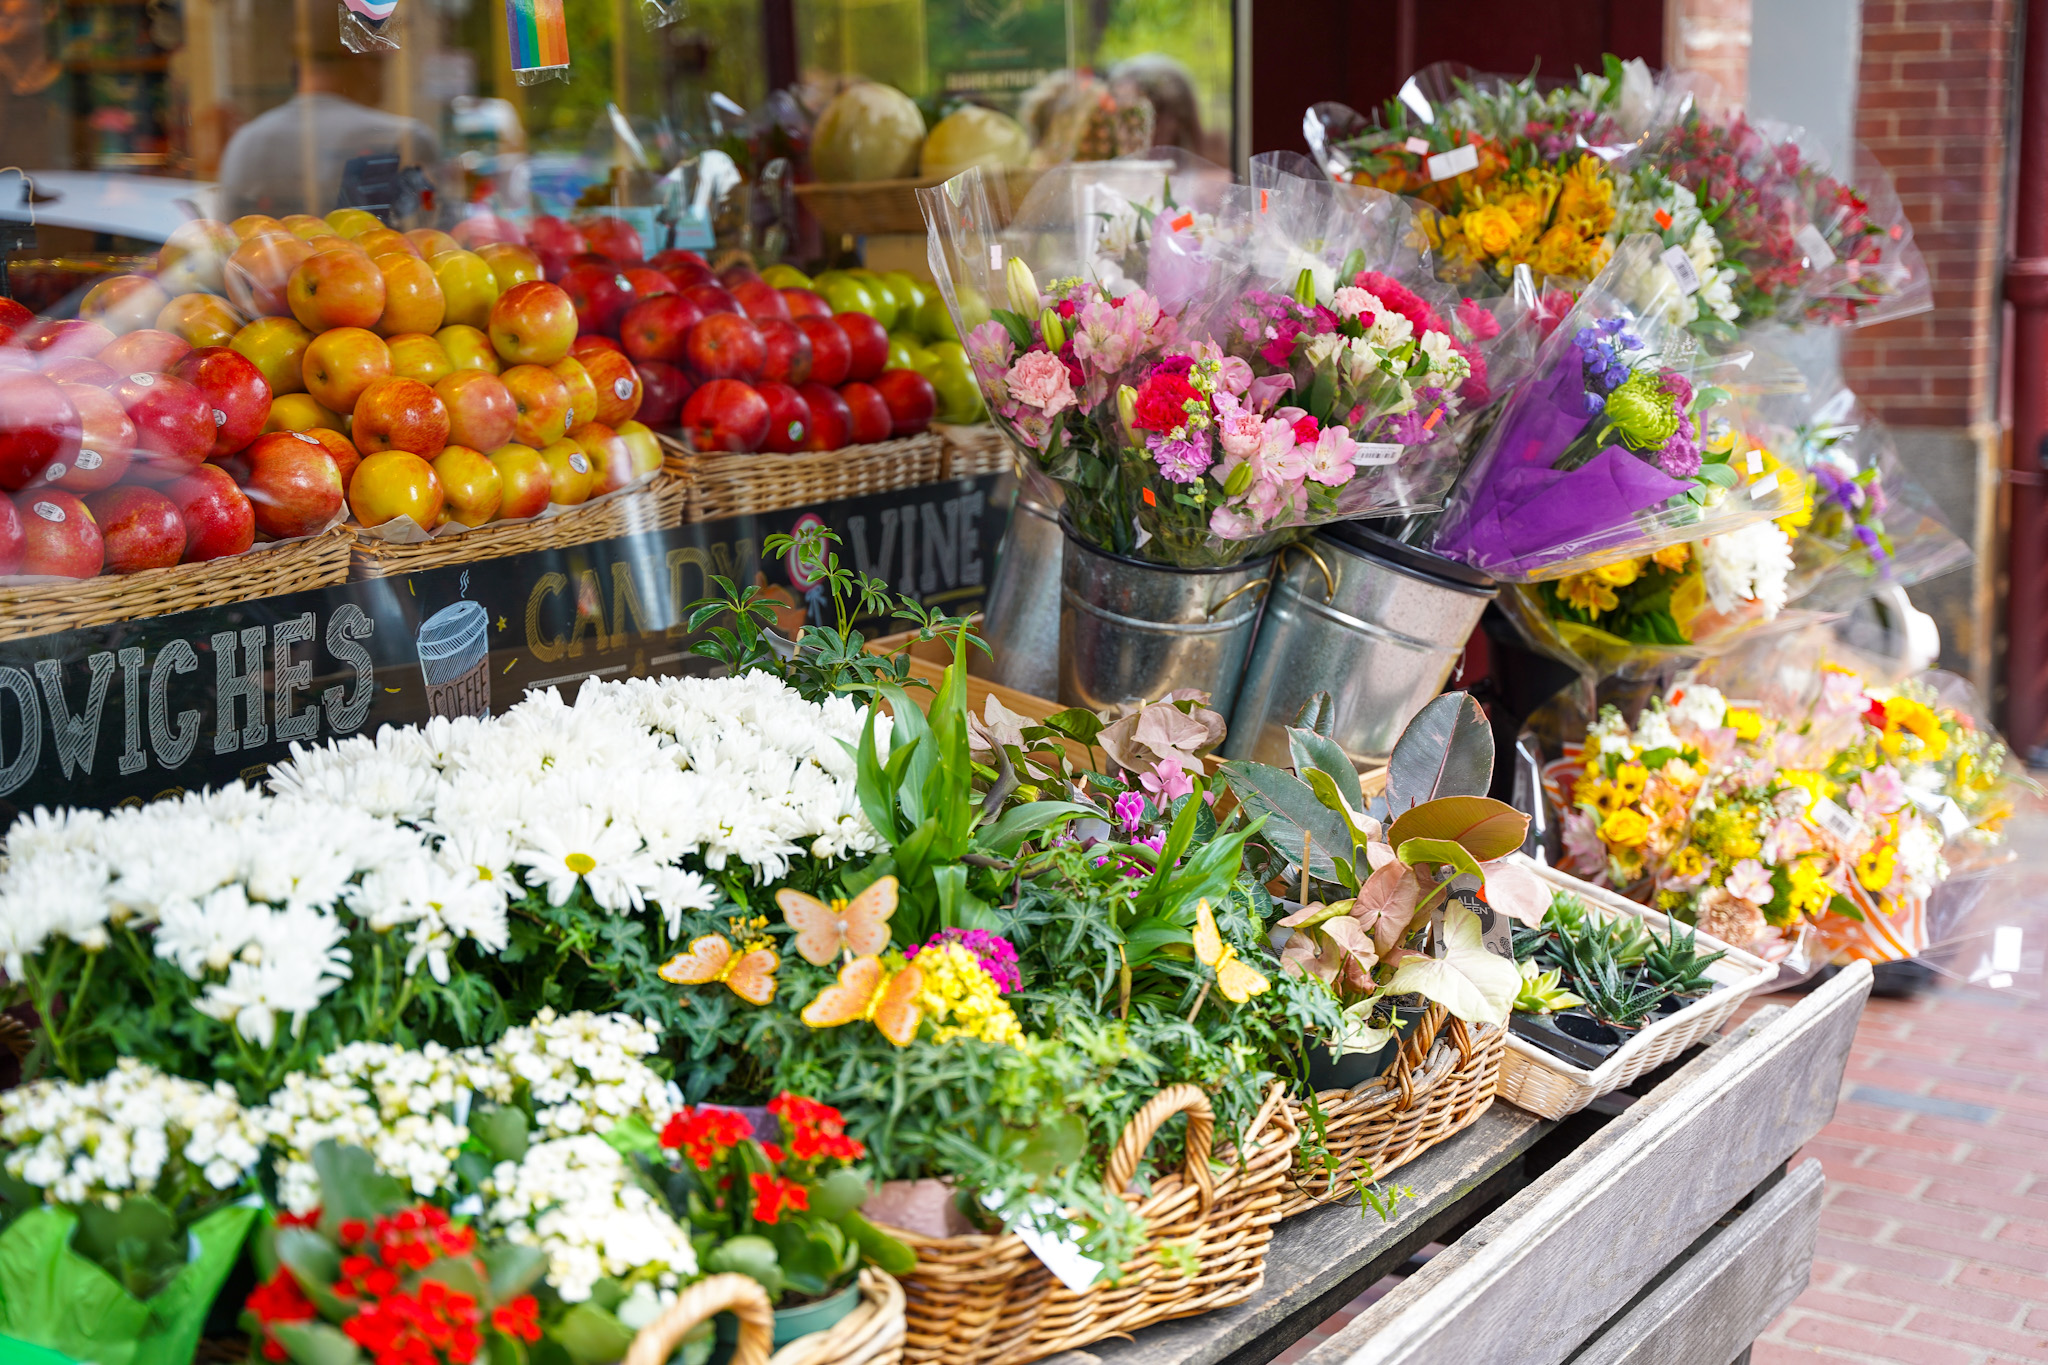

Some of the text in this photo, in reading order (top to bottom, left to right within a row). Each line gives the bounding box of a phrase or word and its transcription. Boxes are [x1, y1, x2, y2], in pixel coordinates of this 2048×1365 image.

[847, 490, 985, 597] WINE
[525, 538, 753, 663] CANDY
[433, 662, 486, 719] COFFEE
